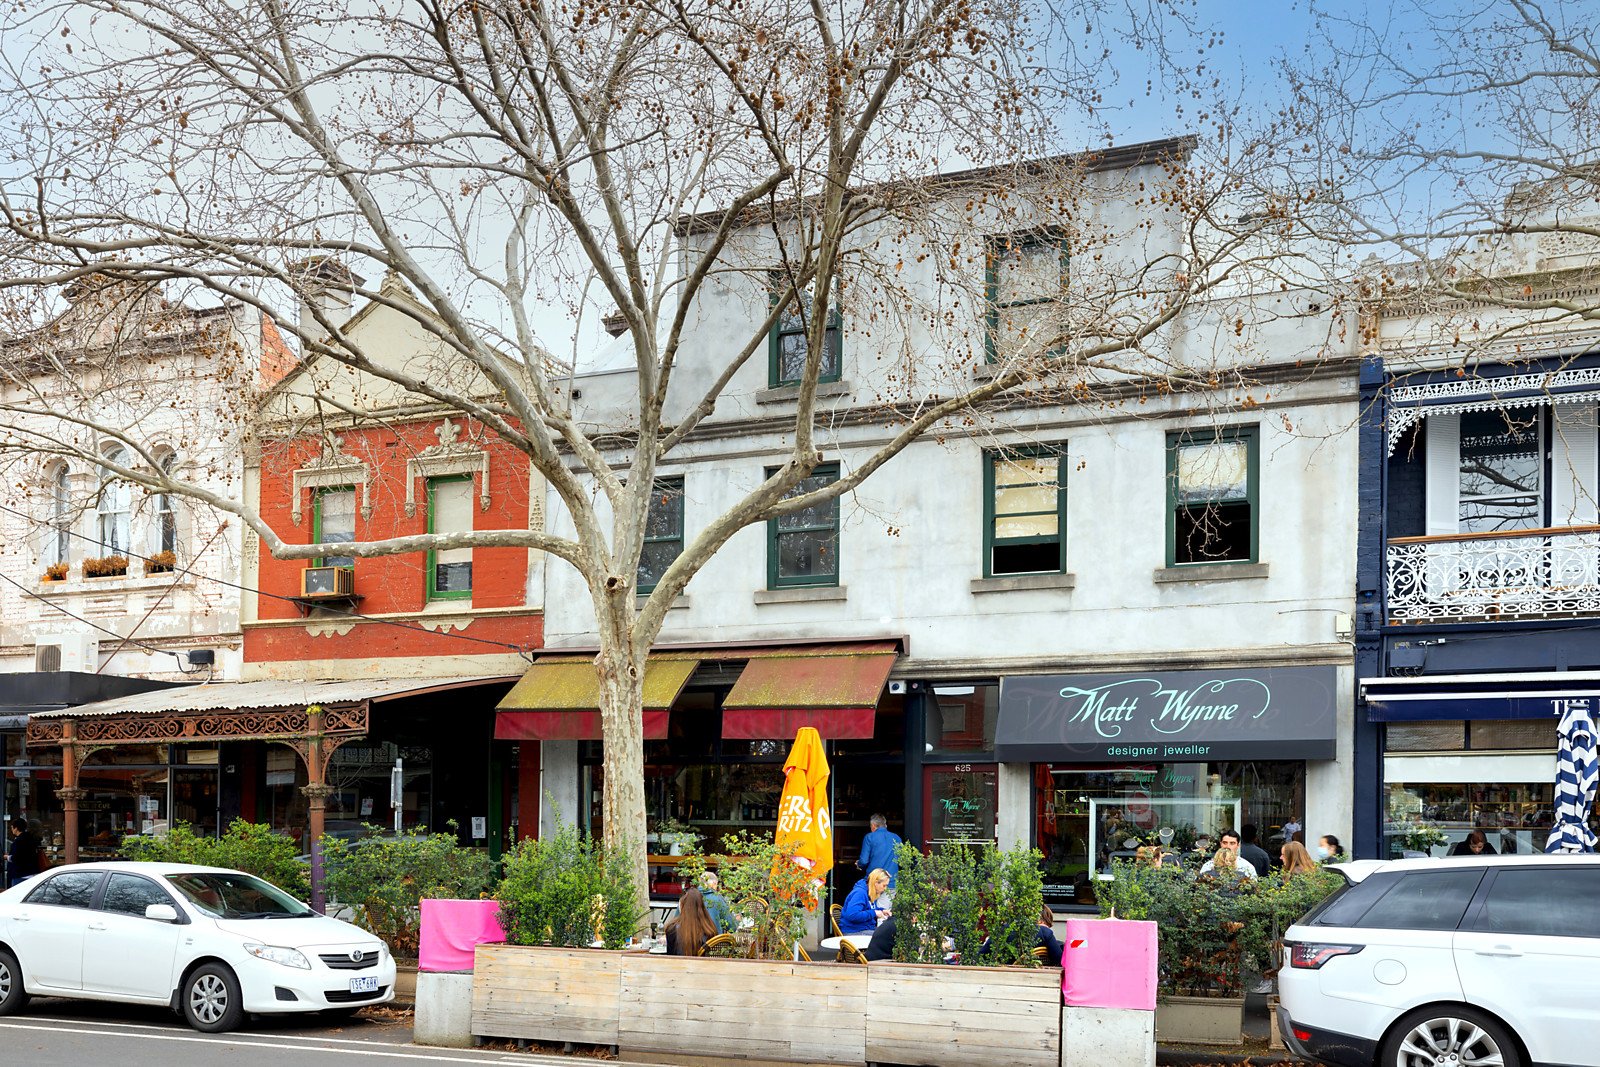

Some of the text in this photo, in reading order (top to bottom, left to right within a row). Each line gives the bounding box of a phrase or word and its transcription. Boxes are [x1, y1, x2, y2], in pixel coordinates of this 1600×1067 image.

[1060, 678, 1162, 738] Matt
[1150, 678, 1270, 734] Wynne
[1551, 699, 1590, 715] TH
[1107, 745, 1210, 757] designer jeweller
[954, 764, 971, 772] 625
